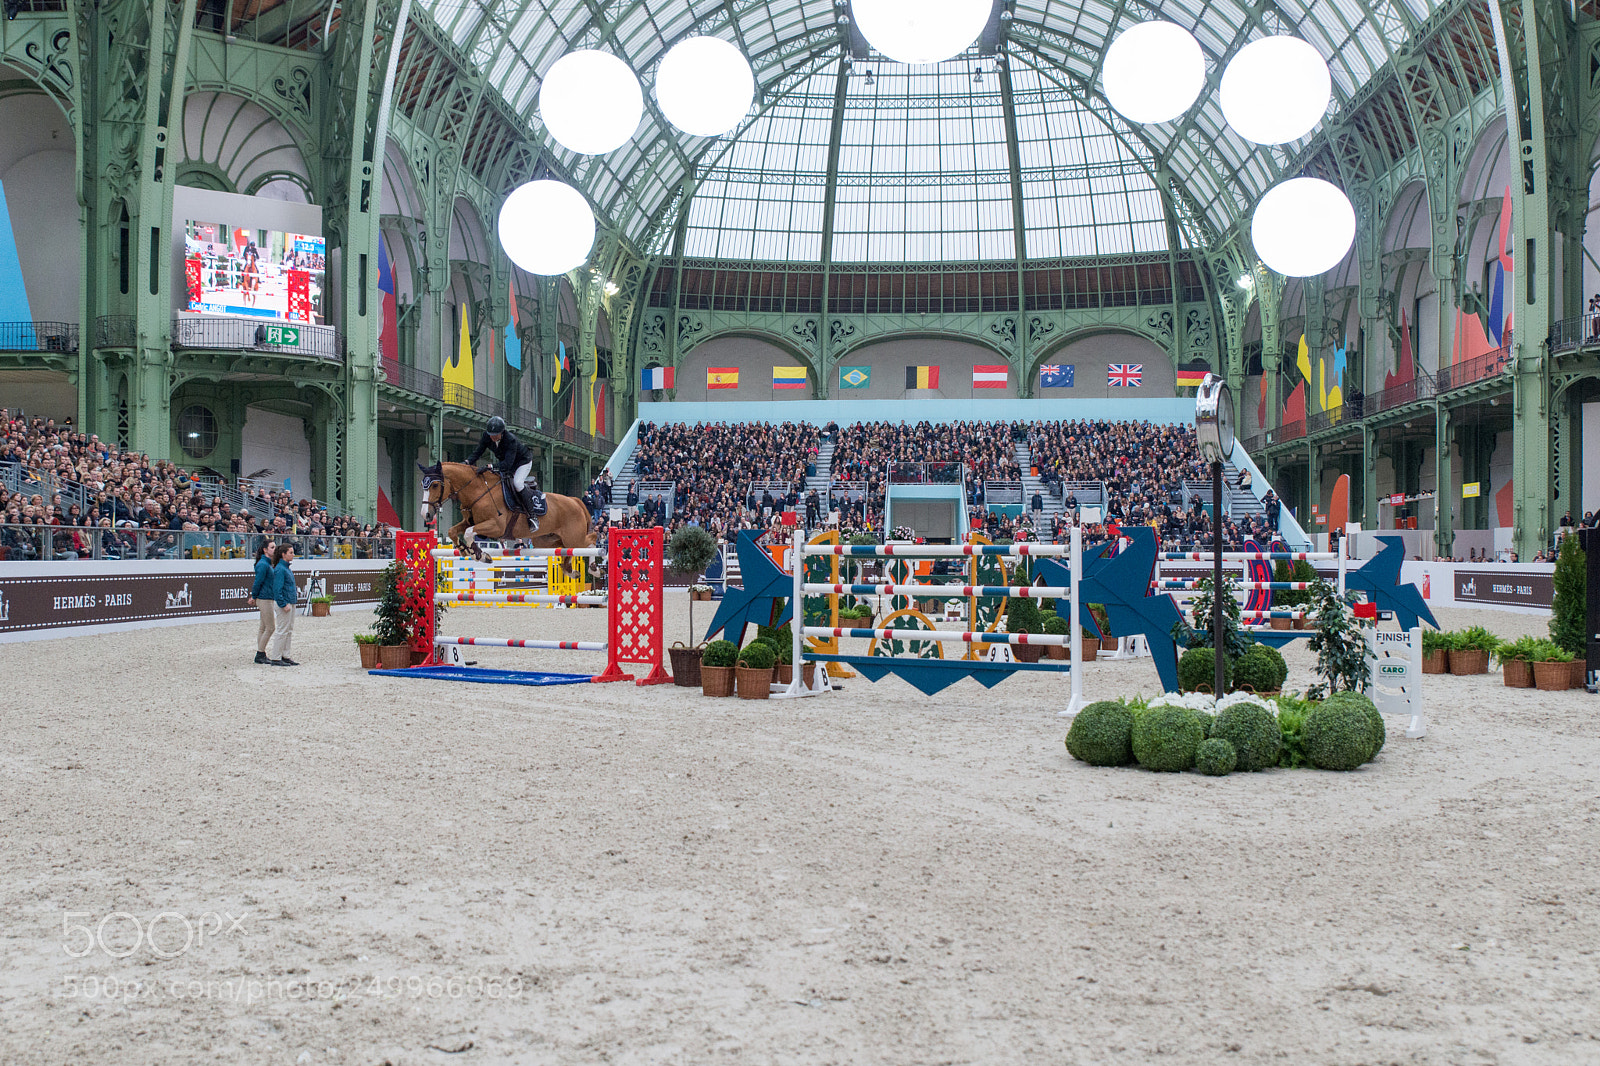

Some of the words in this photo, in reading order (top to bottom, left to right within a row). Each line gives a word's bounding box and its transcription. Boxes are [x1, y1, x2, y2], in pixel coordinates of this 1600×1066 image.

[220, 586, 249, 599] HERMÈS
[357, 582, 371, 592] PARIS
[1516, 585, 1533, 595] PARIS
[53, 593, 96, 610] HERMÈS
[104, 593, 132, 607] PARIS
[1376, 632, 1411, 642] FINISH
[453, 647, 458, 662] 8
[991, 646, 997, 662] 9
[1004, 647, 1009, 662] 9
